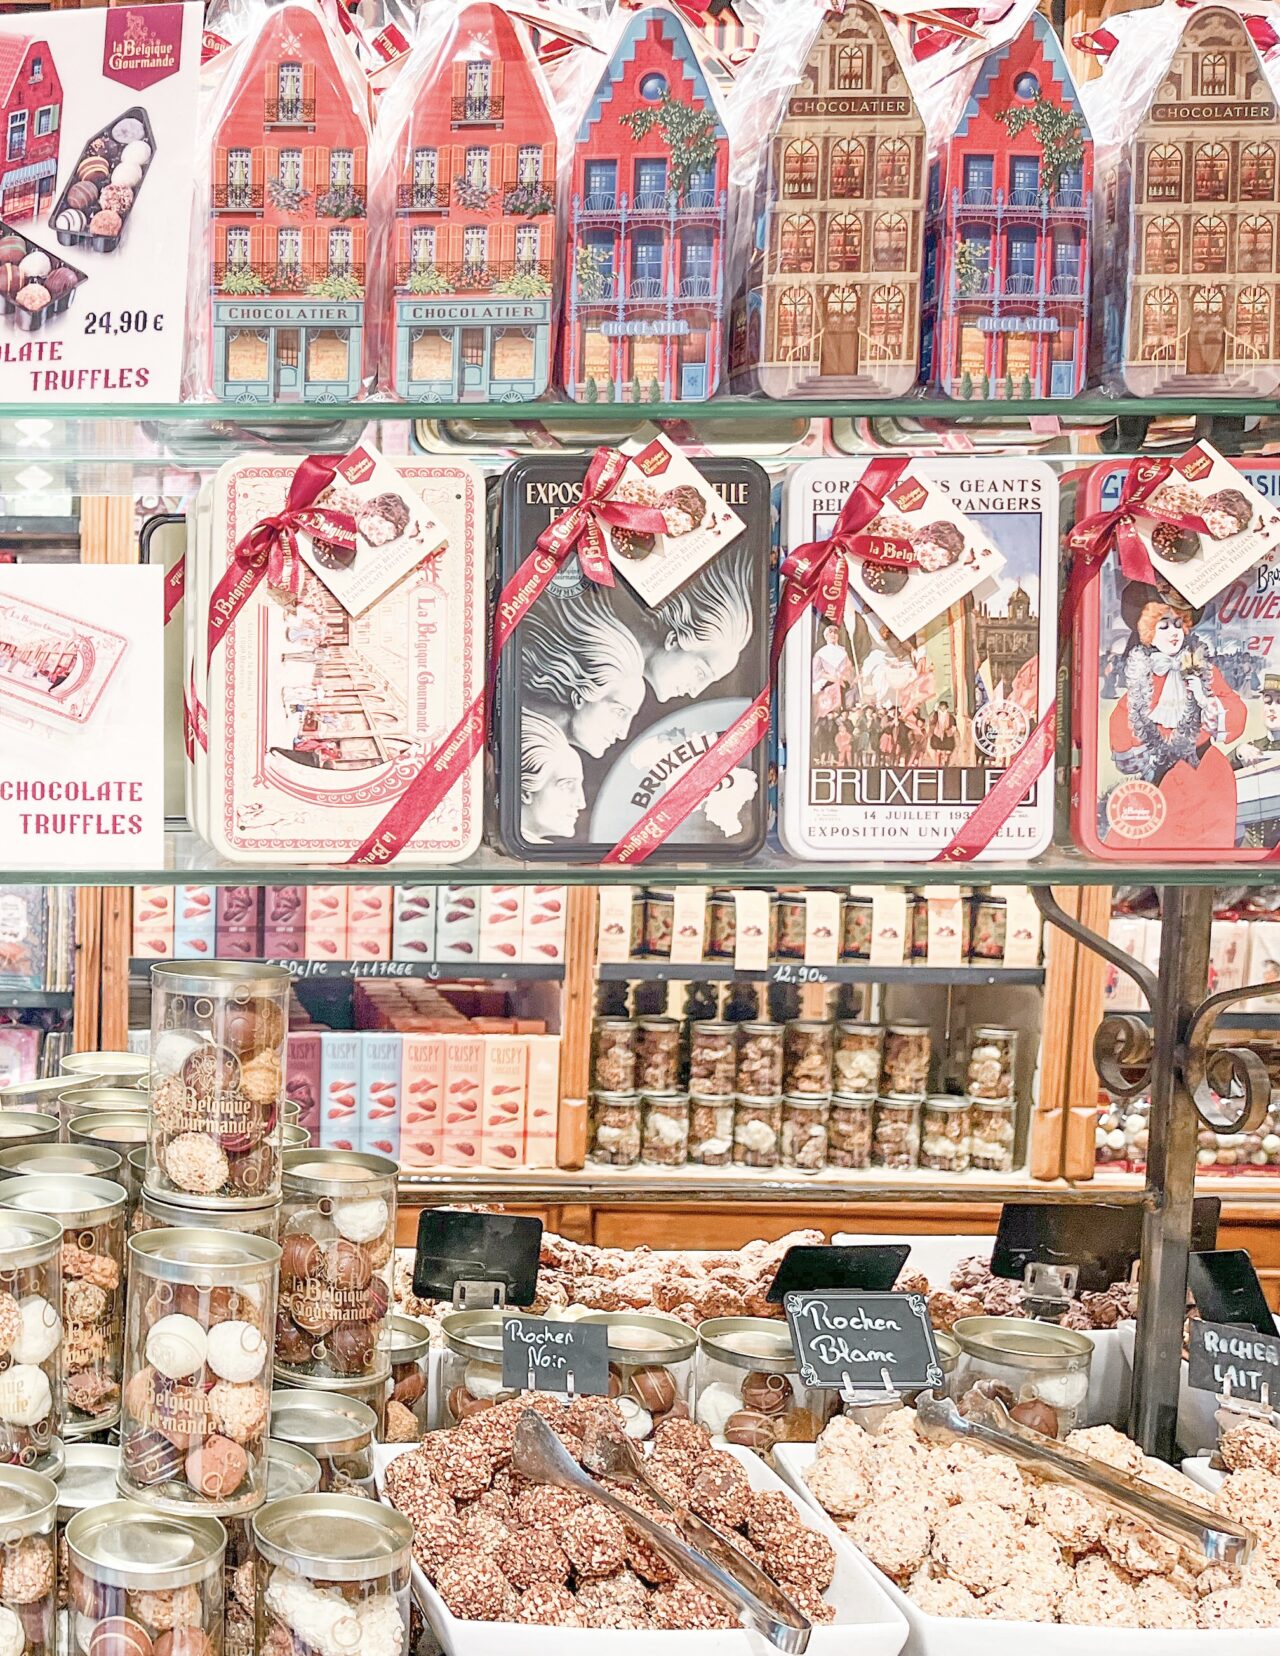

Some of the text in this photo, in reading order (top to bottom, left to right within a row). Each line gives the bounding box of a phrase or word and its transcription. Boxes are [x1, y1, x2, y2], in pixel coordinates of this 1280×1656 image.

[113, 39, 173, 57] la Belgique
[109, 55, 175, 70] Gourmande
[793, 99, 906, 114] CHOCOLATIER
[1158, 105, 1270, 119] CHOCOLATIER
[228, 306, 349, 321] CHOCOLATIER
[412, 306, 536, 321] CHOCOLATIER
[84, 311, 149, 336] 24,90
[30, 367, 150, 392] TRUFFLES
[953, 498, 1042, 511] RANGERS
[870, 543, 880, 555] la
[211, 568, 256, 629] la Belgique
[416, 597, 436, 619] La
[501, 573, 542, 625] Belgique
[1248, 636, 1274, 656] 27
[416, 670, 434, 733] Gourmande
[0, 781, 143, 802] CHOCOLATE
[812, 768, 1035, 803] BRUXELLE
[19, 813, 143, 835] TRUFFLES
[864, 811, 877, 821] 14
[885, 810, 940, 821] JUILLET
[616, 818, 666, 863] Belgique
[808, 826, 909, 838] EXPOSITION
[326, 1042, 358, 1060] CRISPY
[367, 1042, 399, 1061] CRISPY
[408, 1044, 440, 1063] CRISPY
[448, 1044, 481, 1063] CRISPY
[490, 1047, 523, 1066] CRISPY
[293, 1278, 369, 1309] la Belgique
[1213, 1363, 1263, 1391] LAIT
